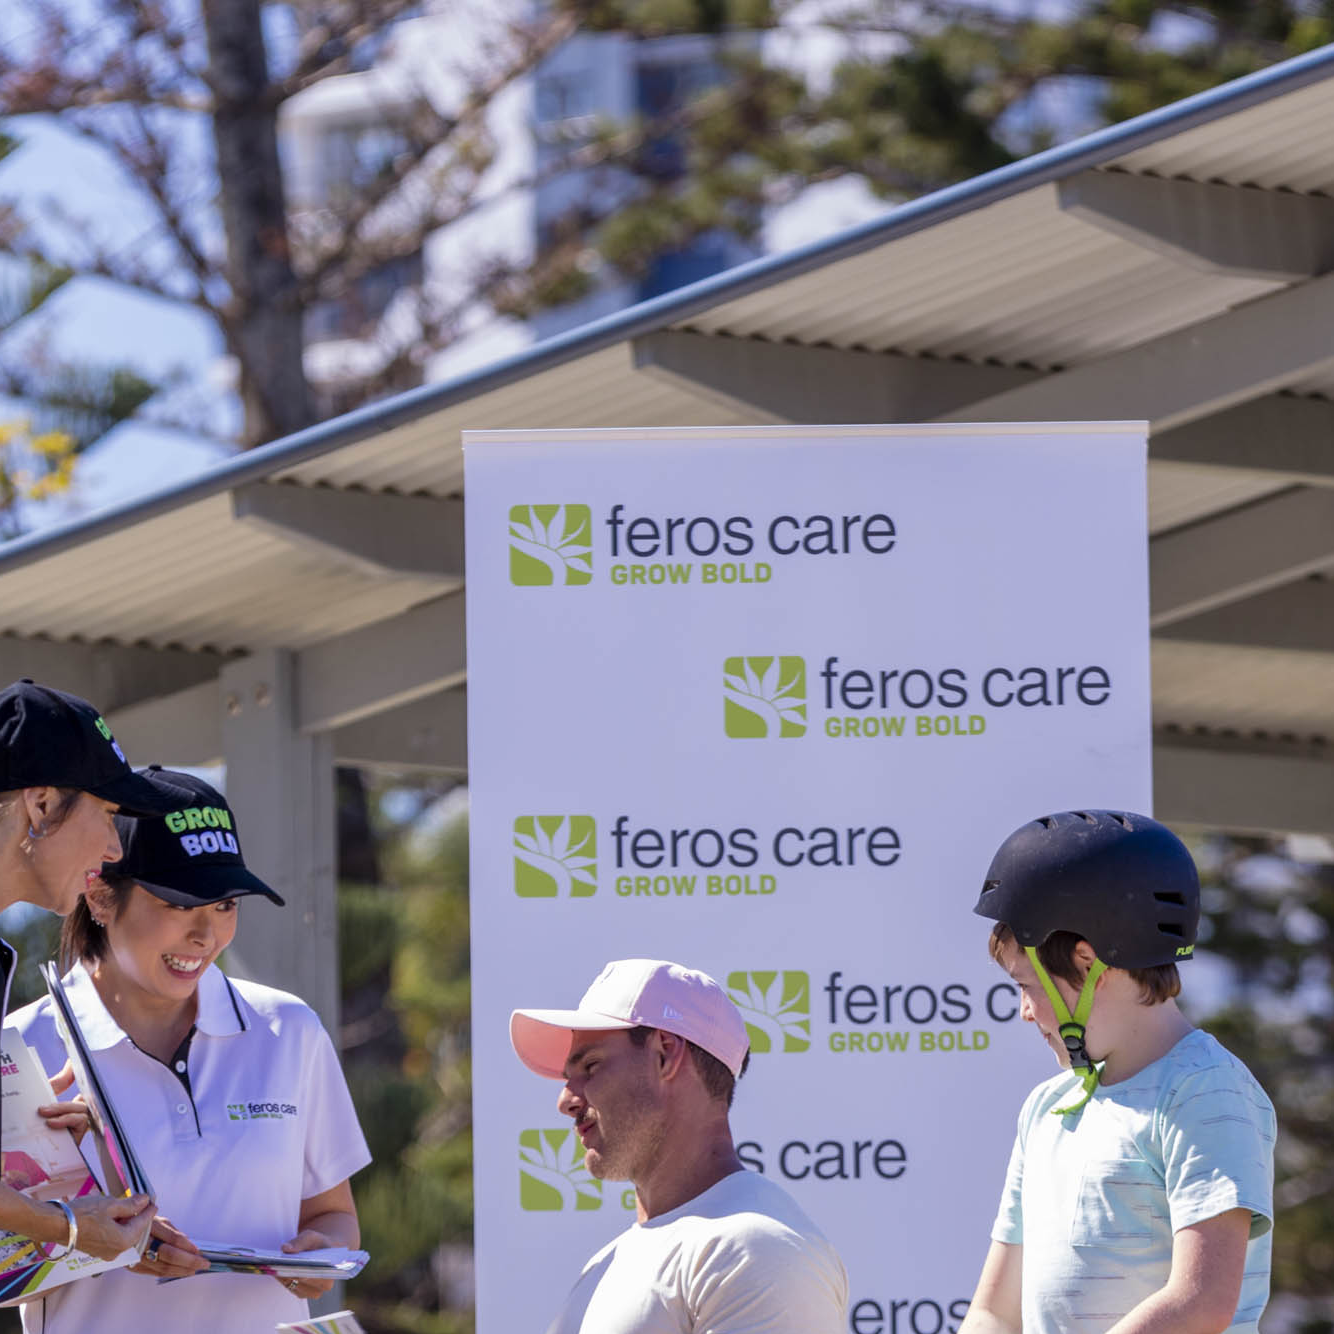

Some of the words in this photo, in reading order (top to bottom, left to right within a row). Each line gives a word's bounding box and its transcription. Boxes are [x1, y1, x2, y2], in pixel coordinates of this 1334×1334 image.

[605, 504, 754, 558] feros
[767, 513, 897, 556] care
[610, 562, 693, 586] GROW
[700, 561, 773, 585] BOLD
[820, 656, 968, 710] feros
[981, 665, 1111, 708] care
[824, 715, 907, 739] GROW
[914, 714, 987, 737] BOLD
[165, 806, 232, 833] GROW
[180, 831, 239, 857] BOLD
[610, 815, 759, 869] feros
[773, 826, 901, 868] care
[614, 874, 698, 897] GROW
[706, 873, 778, 897] BOLD
[824, 971, 972, 1025] feros
[828, 1031, 910, 1054] GROW
[919, 1029, 991, 1053] BOLD
[779, 1139, 908, 1181] care
